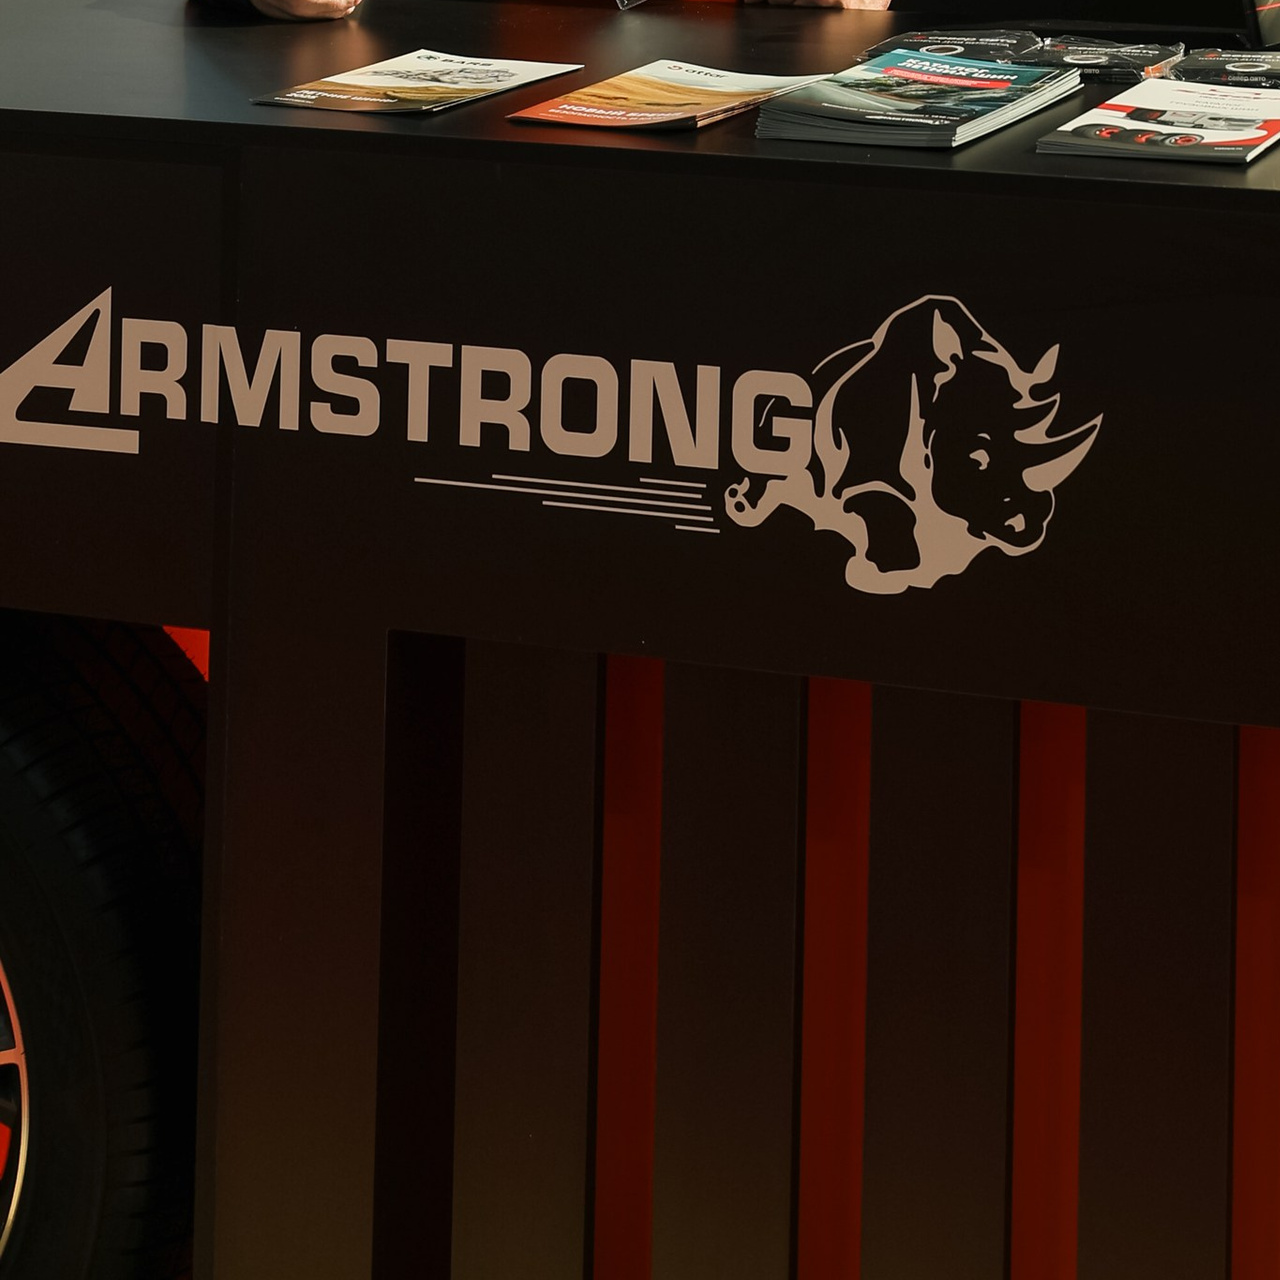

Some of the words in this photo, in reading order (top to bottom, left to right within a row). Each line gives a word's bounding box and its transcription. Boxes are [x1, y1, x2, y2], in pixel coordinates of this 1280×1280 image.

[440, 57, 494, 67] BARS
[904, 58, 990, 73] КАТАЛОГ
[897, 61, 970, 76] ЛЕТНИХ
[971, 72, 1018, 80] ШИН
[558, 103, 627, 116] НОВЫЙ
[0, 285, 814, 478] ARMSTRONG
